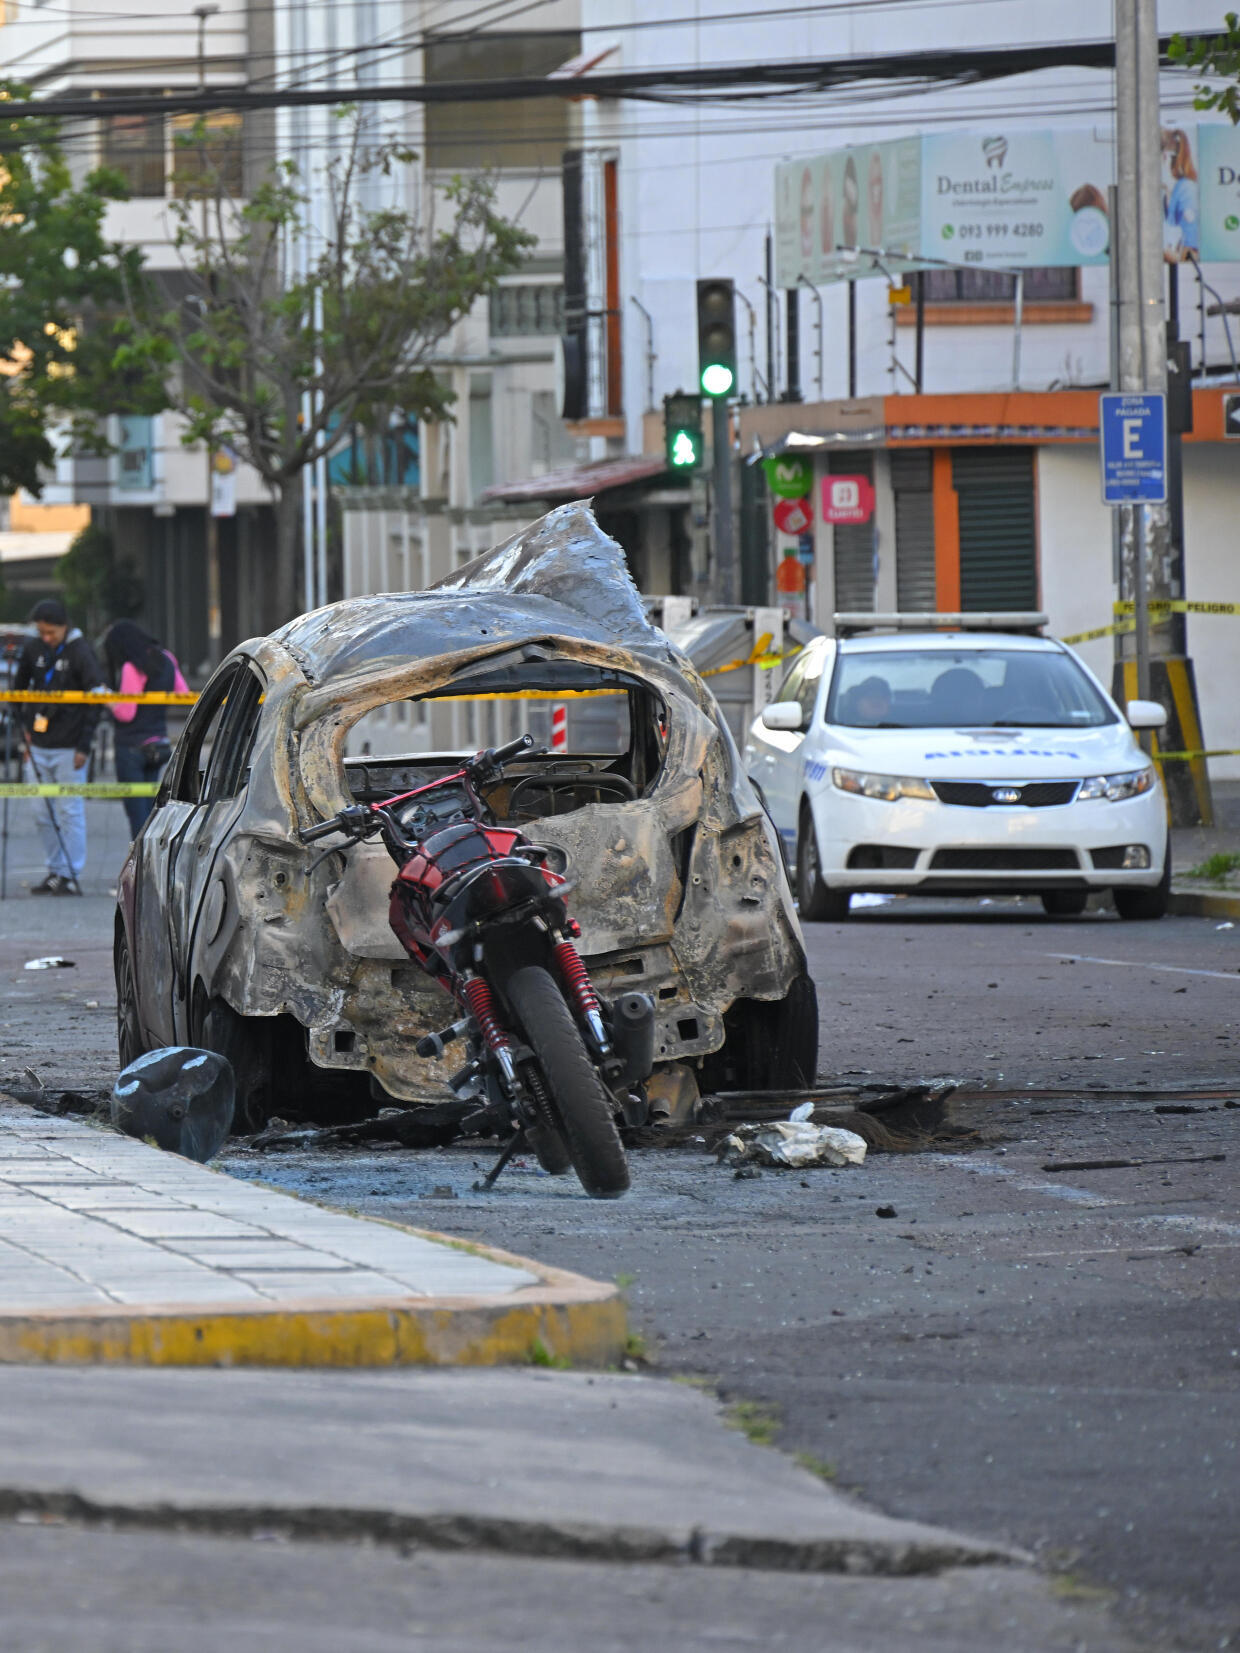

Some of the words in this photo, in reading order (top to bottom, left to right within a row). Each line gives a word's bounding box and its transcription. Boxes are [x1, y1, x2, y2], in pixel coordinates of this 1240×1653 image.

[937, 175, 997, 195] Dental
[959, 223, 982, 239] 093
[986, 223, 1009, 238] 999
[1012, 222, 1044, 238] 4280
[1115, 407, 1151, 417] PAGADA
[1123, 418, 1144, 459] E
[1187, 603, 1235, 614] PELIGRO
[60, 785, 133, 796] PROHIBIDO
